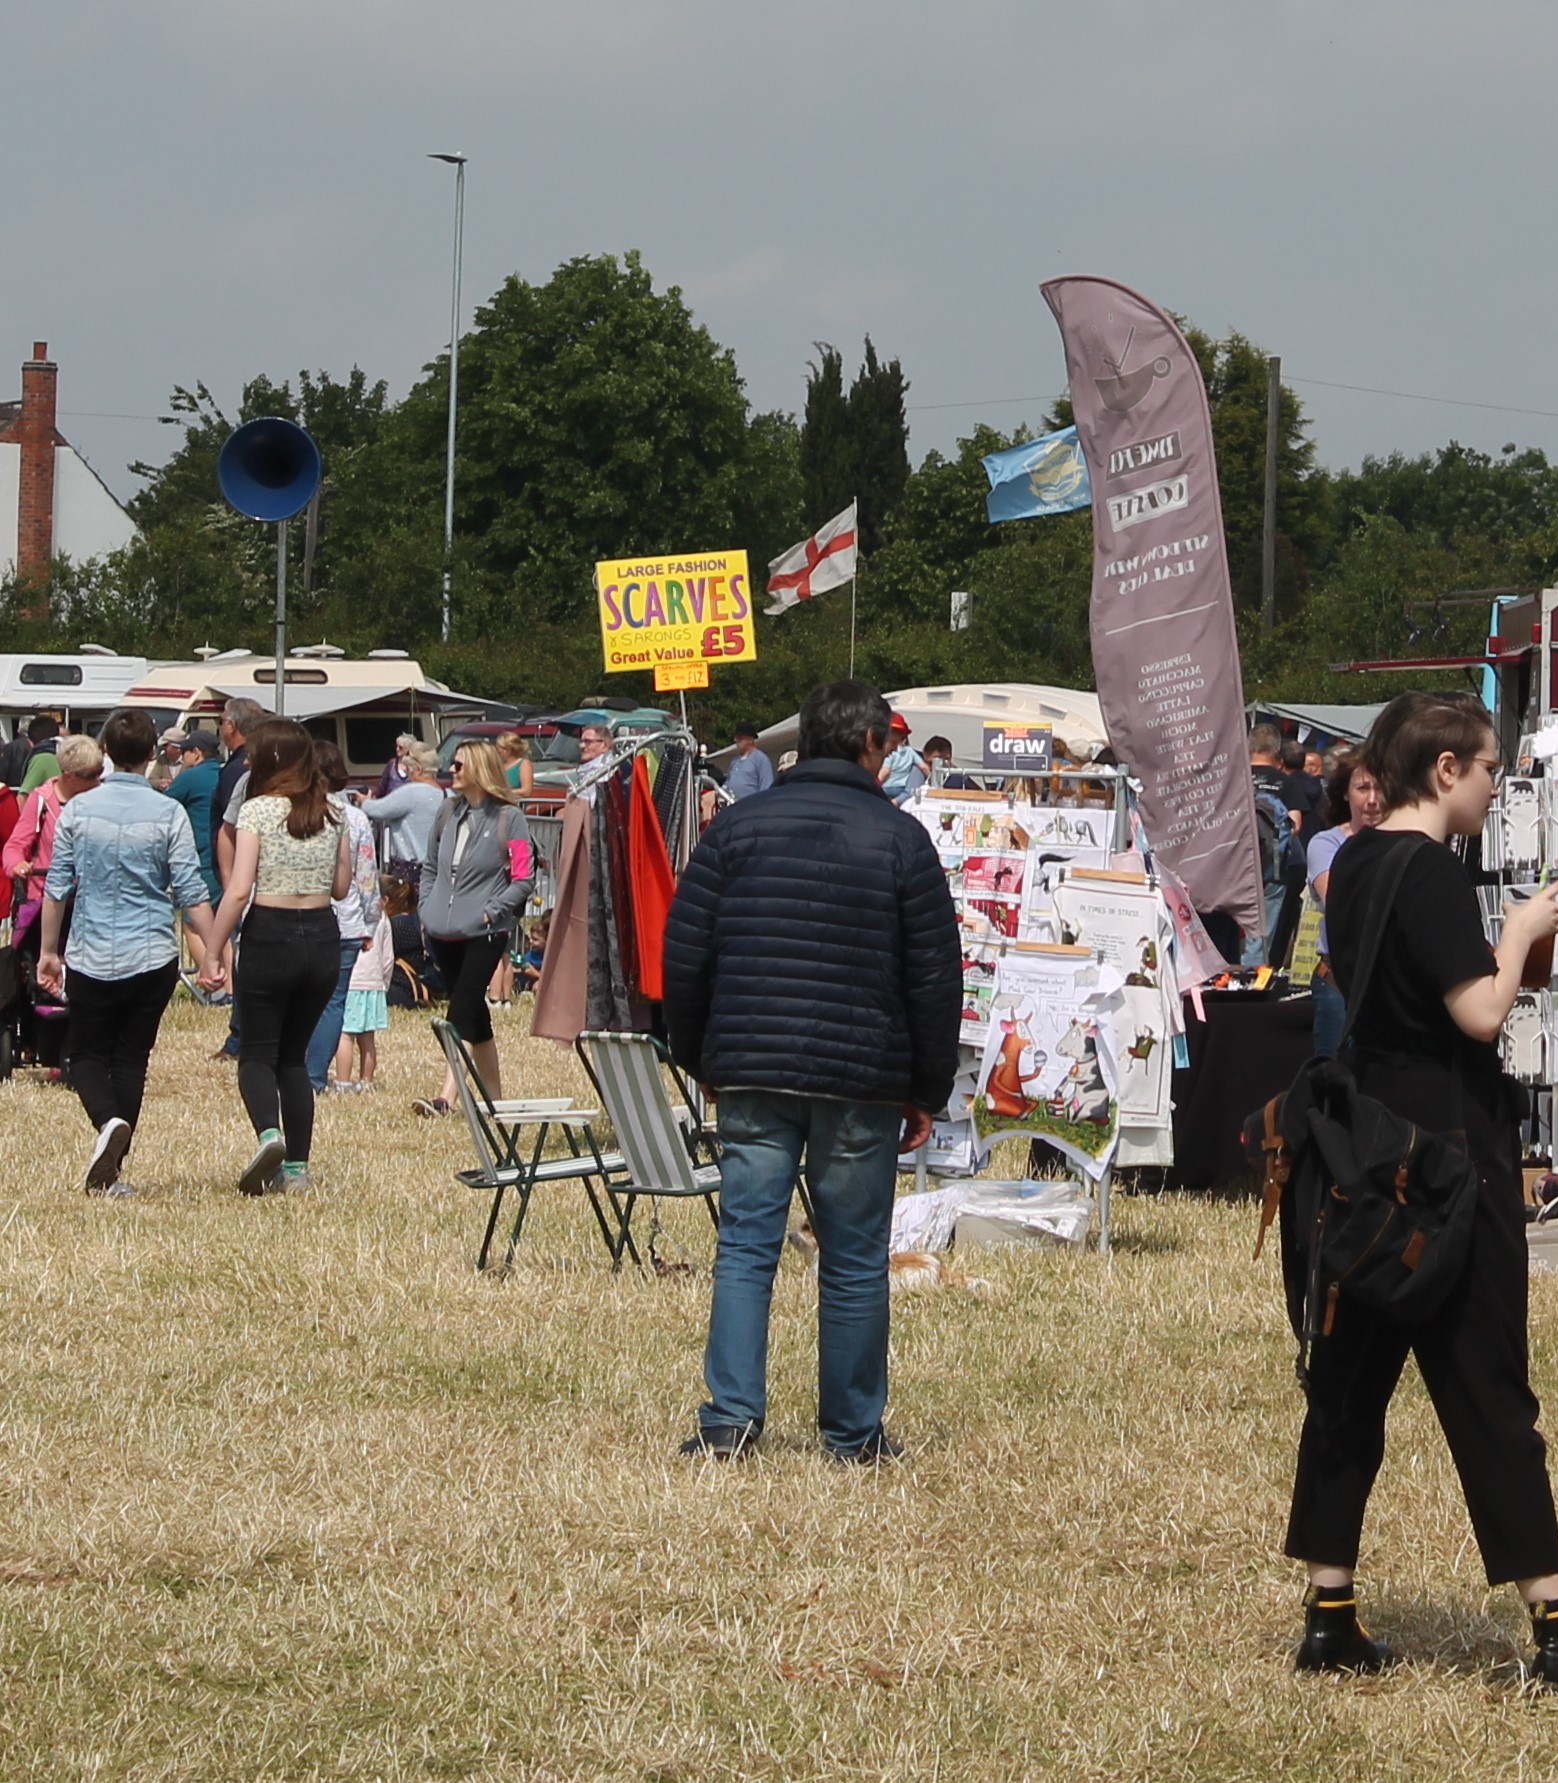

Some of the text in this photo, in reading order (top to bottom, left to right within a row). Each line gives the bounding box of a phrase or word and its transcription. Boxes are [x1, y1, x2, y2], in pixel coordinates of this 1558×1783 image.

[617, 559, 727, 579] LARGE FASHION
[603, 574, 748, 631] SCARVES
[621, 629, 691, 647] SARONGS
[701, 625, 746, 658] £5
[611, 647, 695, 665] Great Value
[661, 673, 670, 687] 3
[989, 733, 1046, 754] draw
